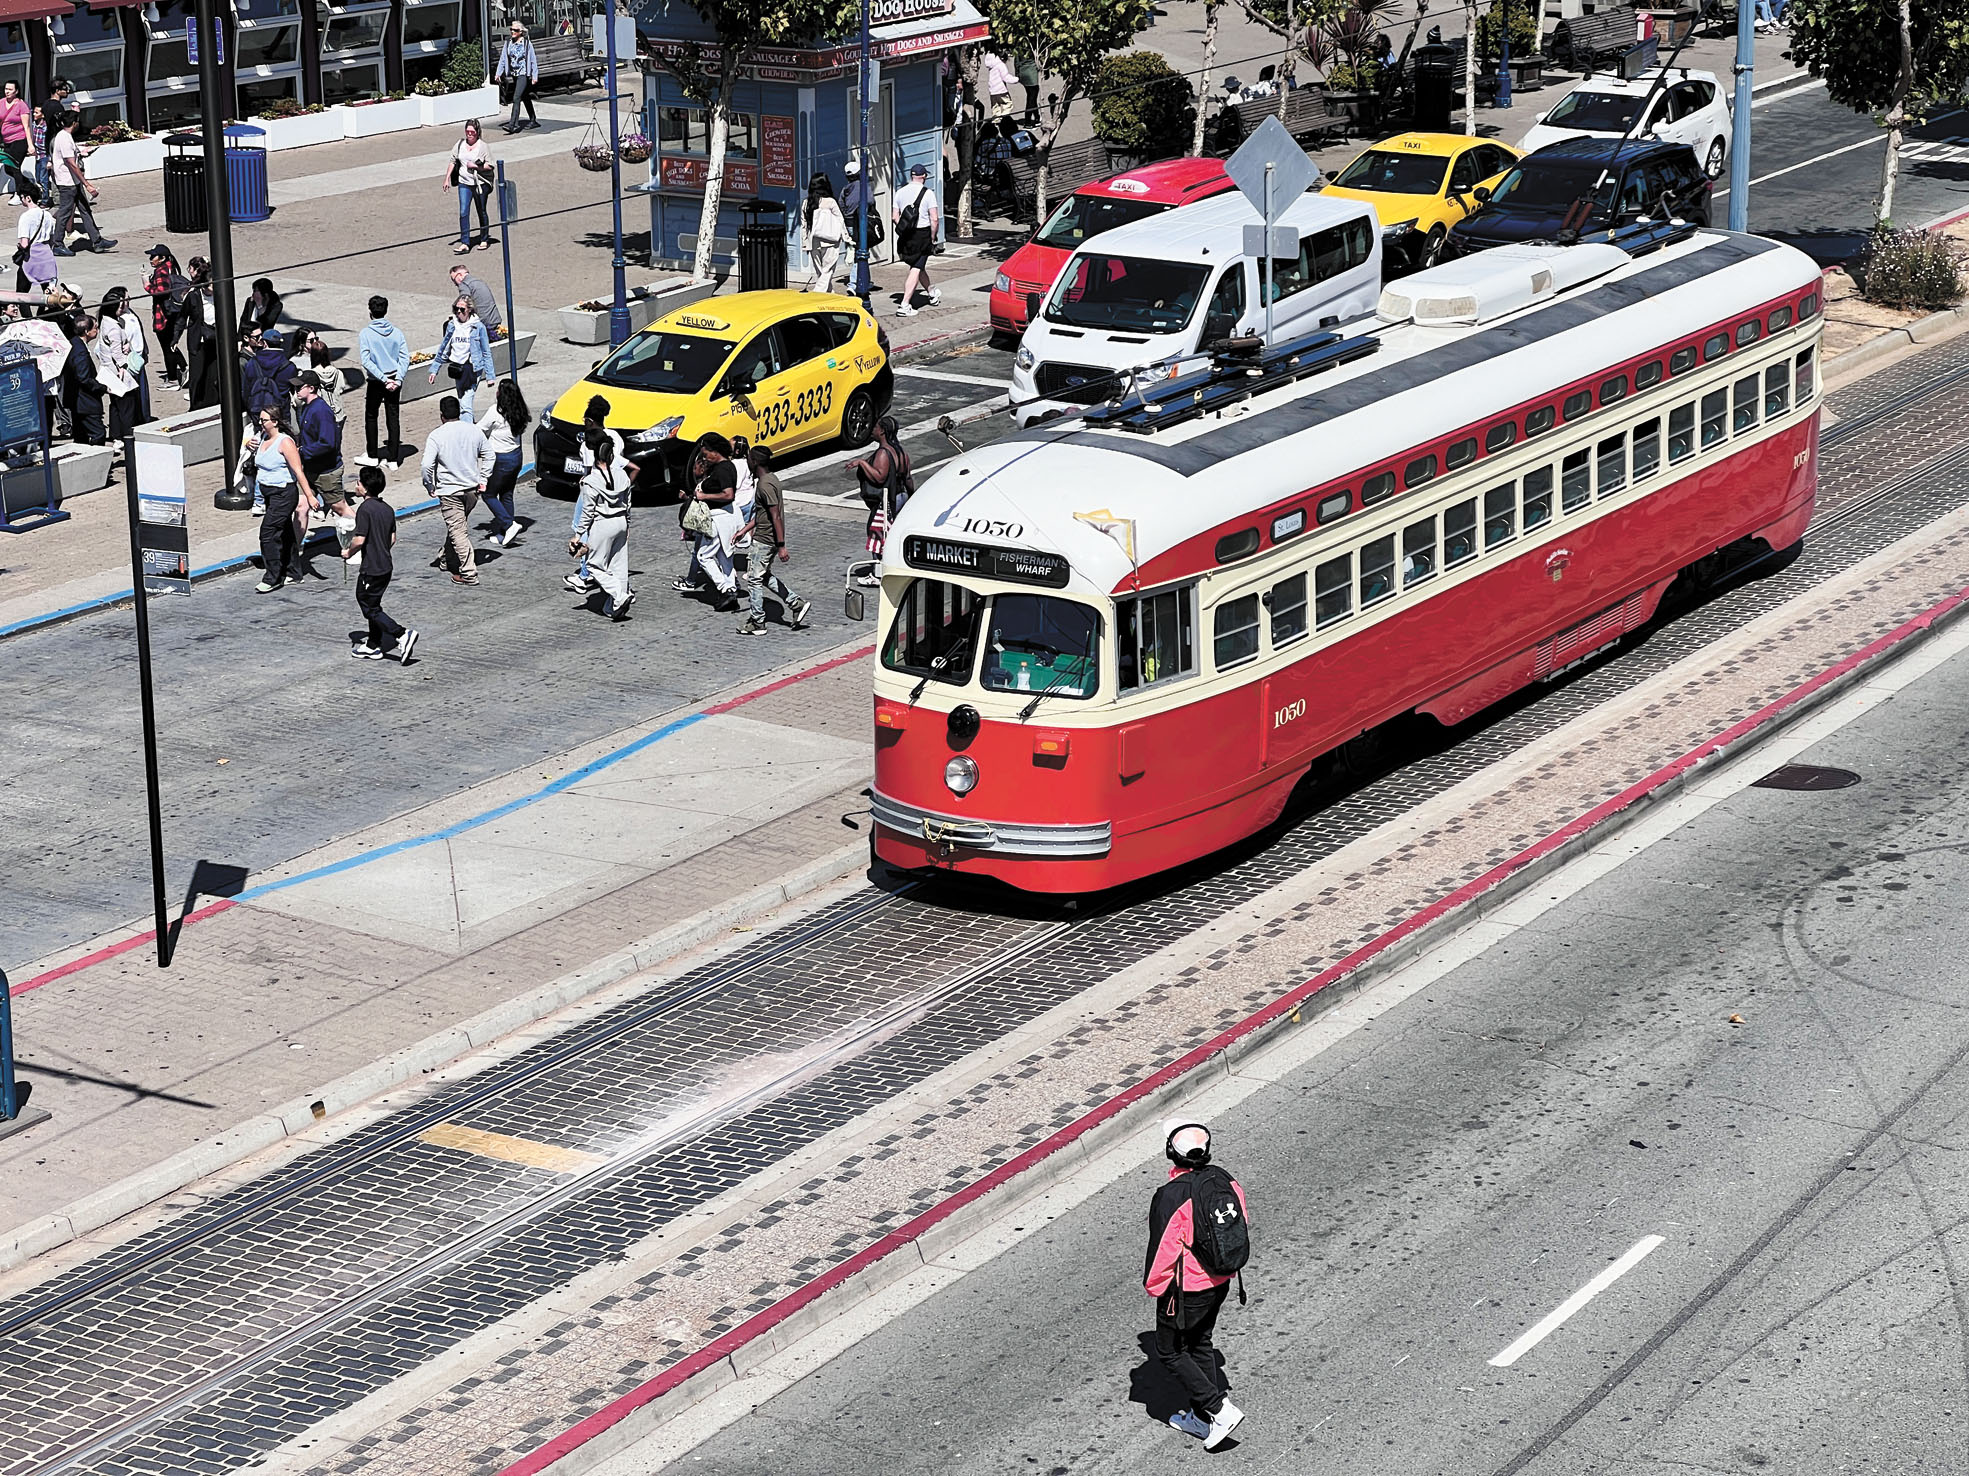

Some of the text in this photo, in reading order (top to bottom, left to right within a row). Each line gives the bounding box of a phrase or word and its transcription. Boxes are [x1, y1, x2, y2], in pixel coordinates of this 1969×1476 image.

[873, 0, 901, 17] DOG
[844, 46, 879, 60] GOUET
[897, 37, 916, 50] DOGS
[918, 35, 932, 46] AND
[933, 29, 965, 44] SAUSAGES
[750, 51, 797, 64] SAUSAGES
[1403, 141, 1421, 149] TAXI
[730, 181, 751, 190] SODA
[1116, 182, 1136, 190] TAXI
[681, 314, 716, 328] YELLOW
[864, 356, 881, 370] YELLOW
[10, 378, 21, 391] 39
[760, 380, 833, 441] 333-3333
[1793, 448, 1810, 470] 1050
[962, 517, 1024, 539] 1050
[143, 551, 156, 564] 39
[913, 541, 1068, 569] F MARKET FISHERMAN'S
[1015, 563, 1052, 576] WHARF
[1272, 698, 1307, 730] 1050
